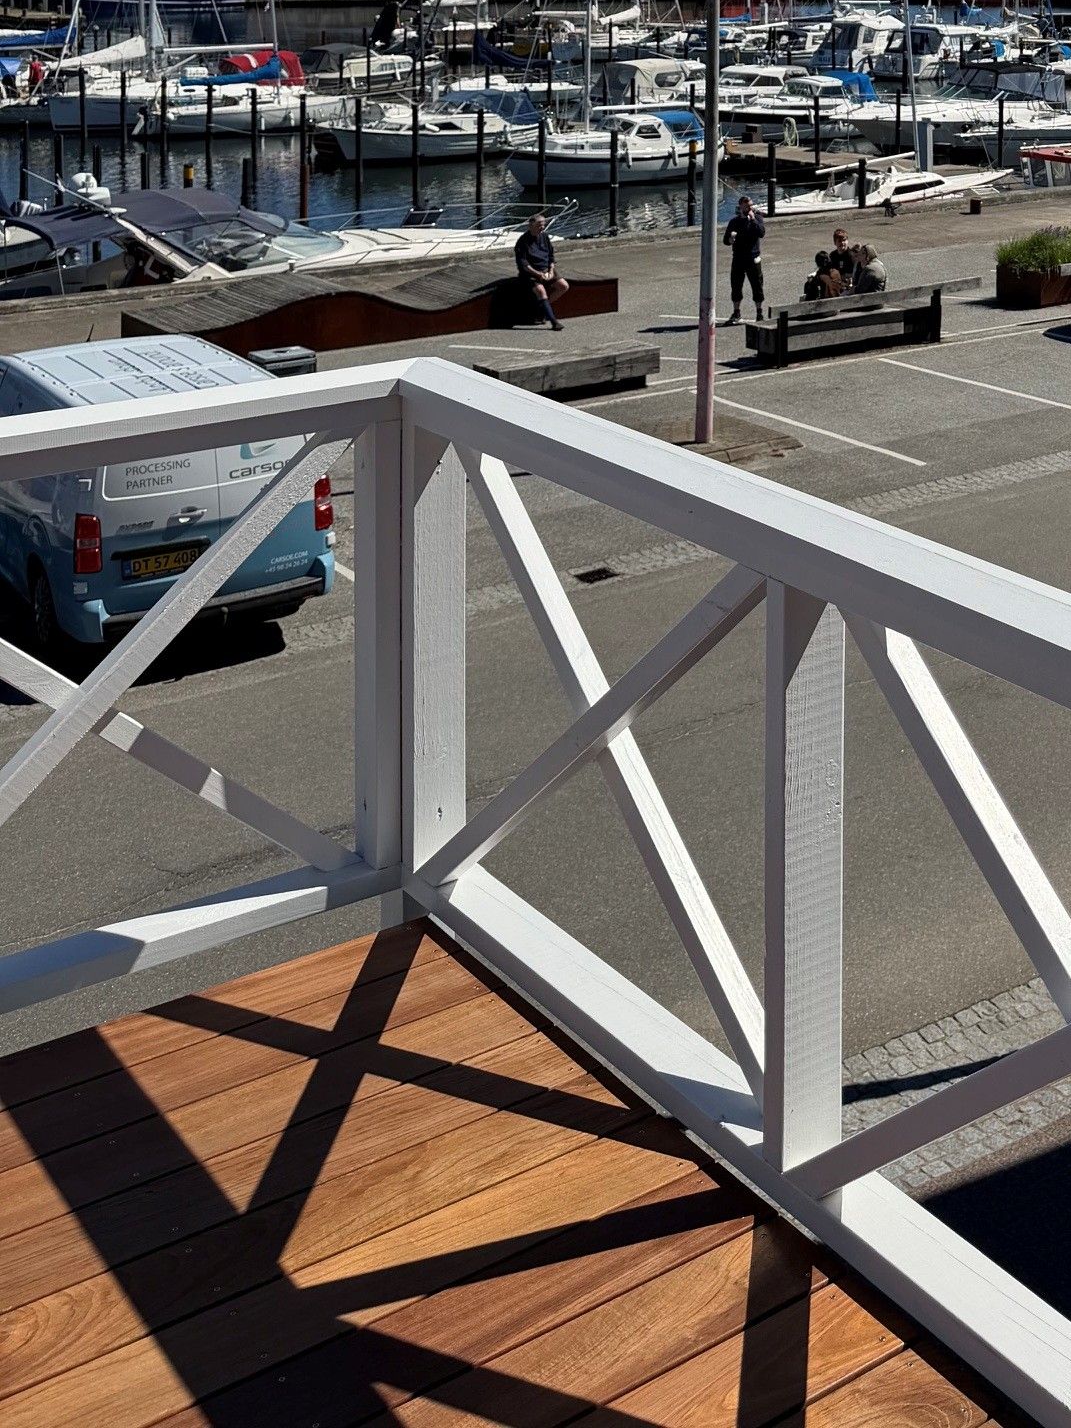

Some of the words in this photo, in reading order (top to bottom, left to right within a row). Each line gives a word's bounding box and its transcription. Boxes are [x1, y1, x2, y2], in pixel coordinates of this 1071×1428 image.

[125, 458, 191, 476] PROCESSING
[126, 475, 173, 490] PARTNER
[155, 554, 171, 570] 57
[173, 549, 199, 566] 408
